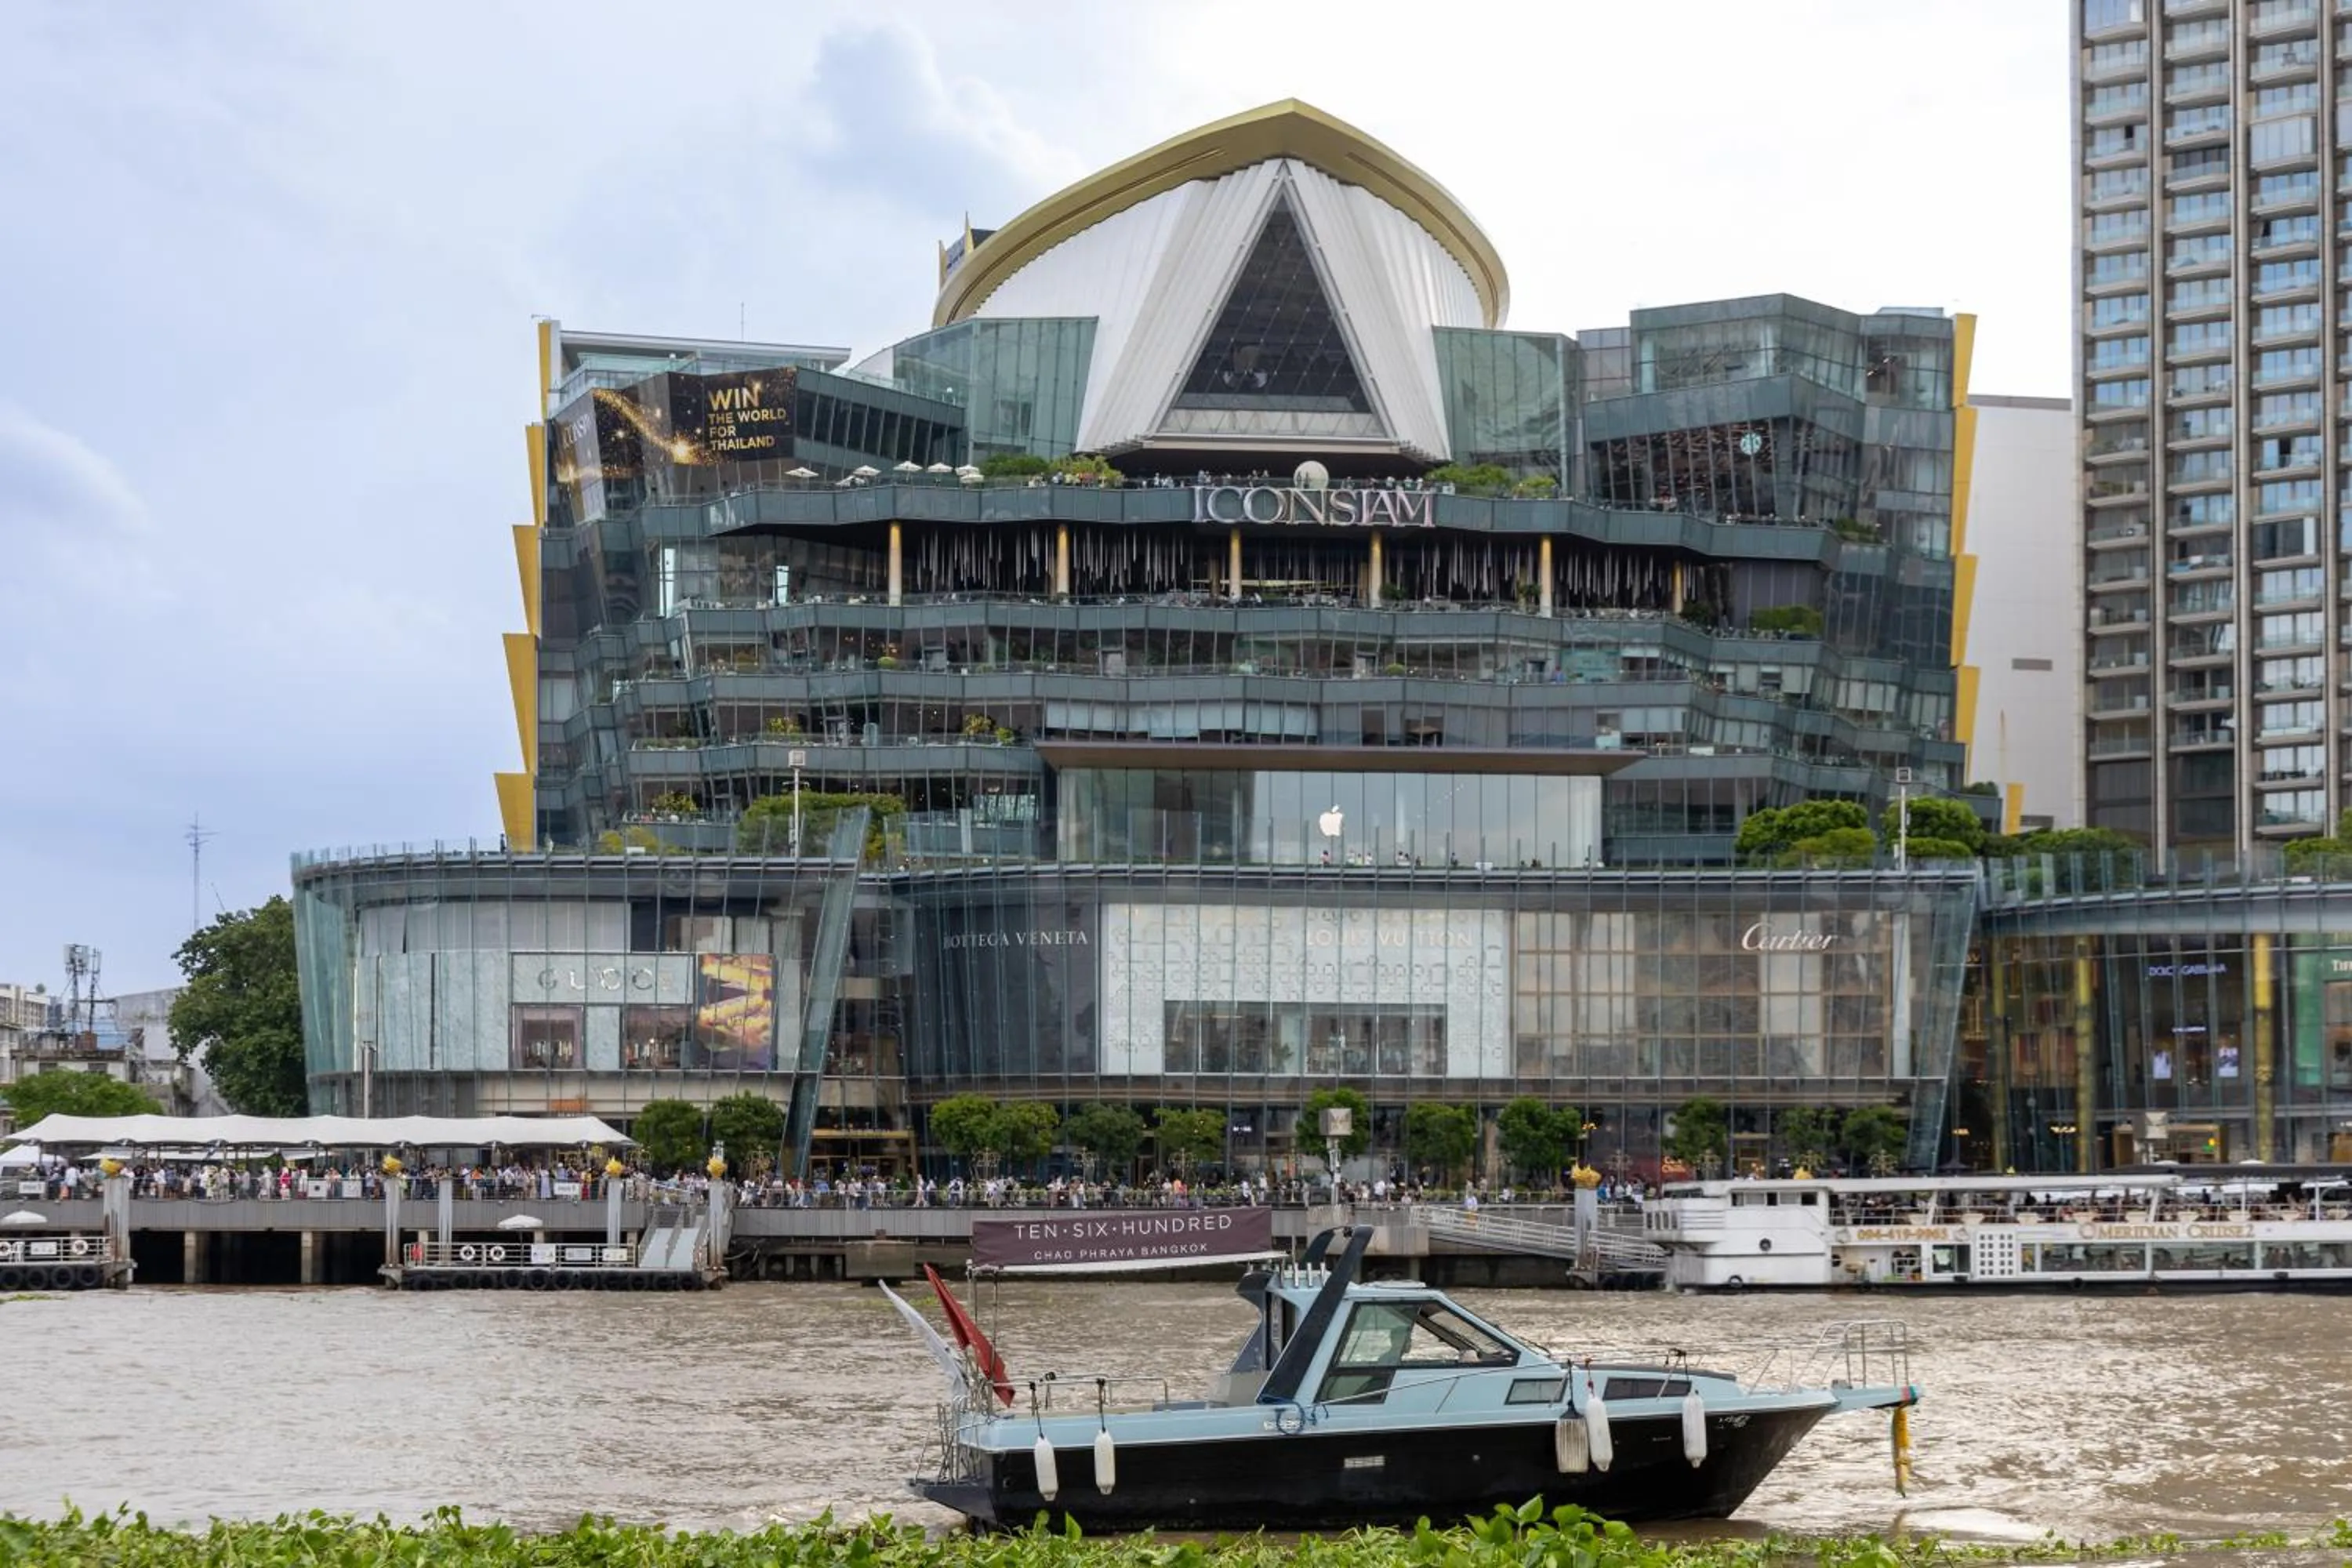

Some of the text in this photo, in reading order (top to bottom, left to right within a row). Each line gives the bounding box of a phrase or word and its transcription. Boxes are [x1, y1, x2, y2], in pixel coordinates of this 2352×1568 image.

[708, 385, 760, 411] WIN
[708, 408, 786, 425] THE WORLD
[710, 425, 736, 438] FOR
[710, 435, 775, 451] THAILAND
[1192, 485, 1436, 528] ICONSIAM
[1015, 929, 1088, 946] VENETA
[1742, 922, 1838, 950] Cartier
[1034, 1243, 1208, 1260] CHAO PHRAYA BANGKOK
